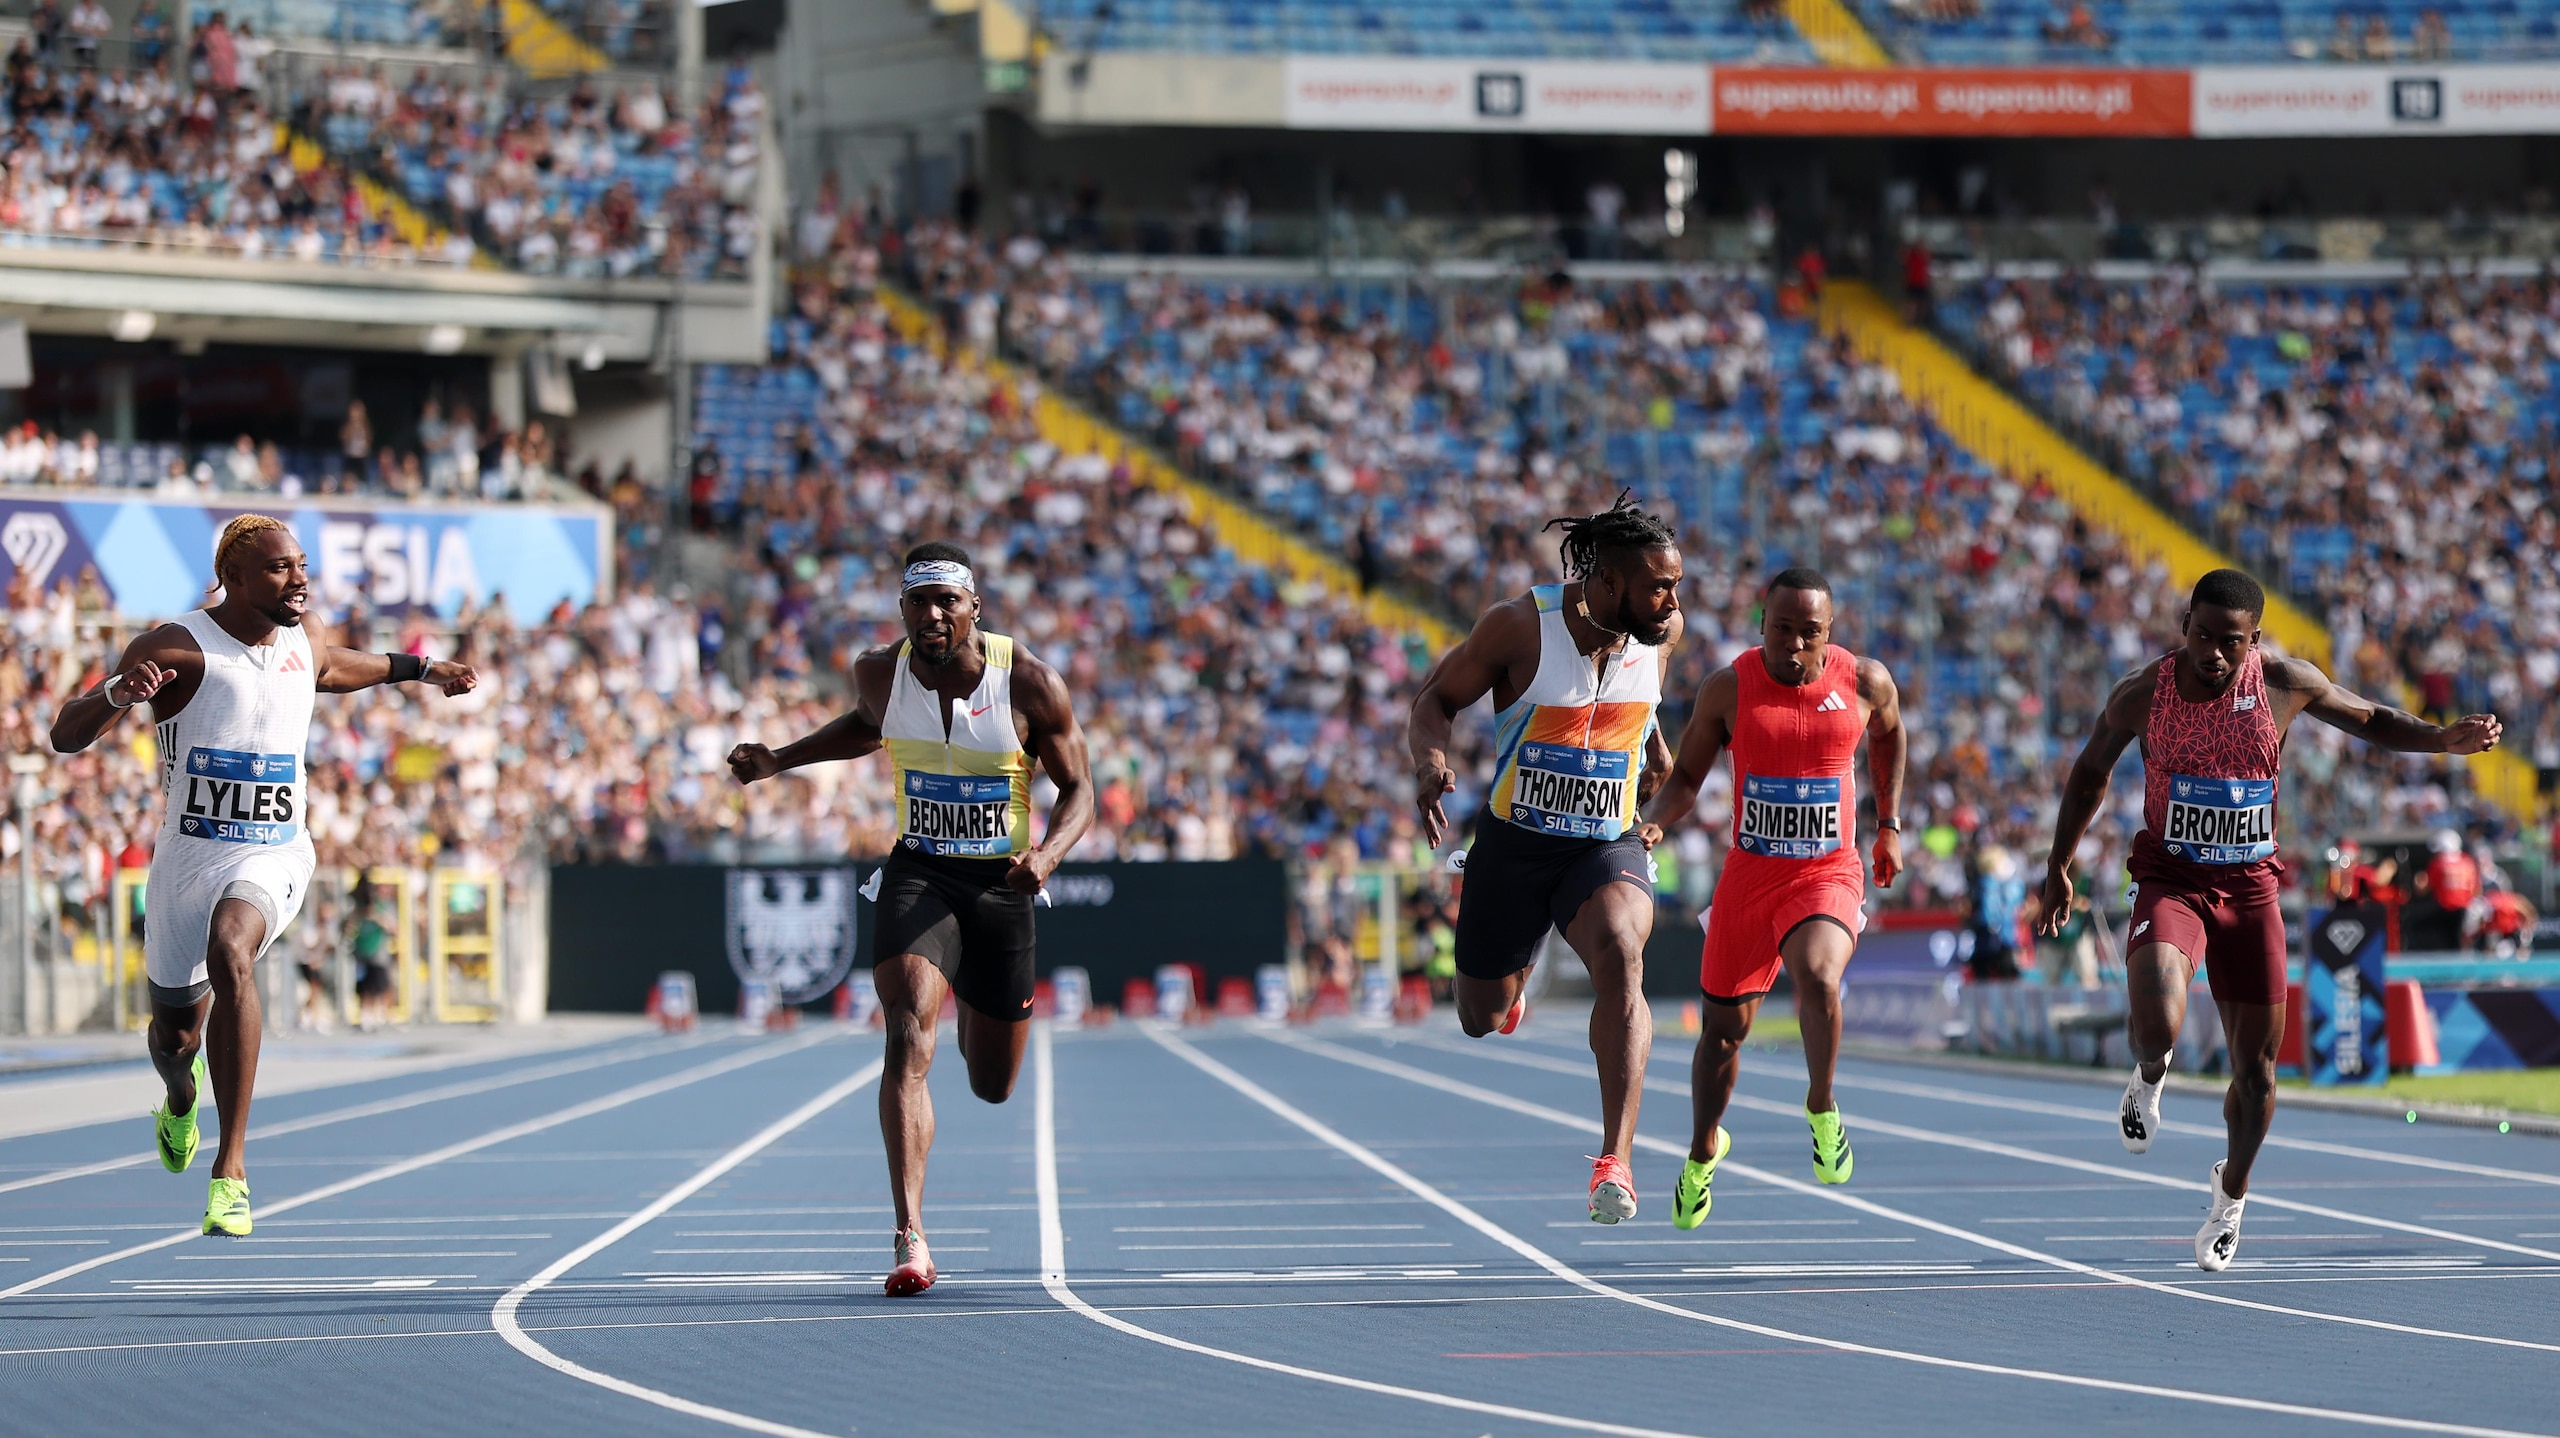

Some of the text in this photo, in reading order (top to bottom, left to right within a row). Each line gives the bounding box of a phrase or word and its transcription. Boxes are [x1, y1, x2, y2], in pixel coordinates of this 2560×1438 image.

[1721, 78, 2133, 121] superauto.pl superauto.pl
[186, 777, 292, 822] LYLES
[1520, 768, 1622, 818] THOMPSON
[218, 824, 281, 841] SILESIA
[909, 798, 1007, 838] BEDNAREK
[1545, 815, 1607, 836] SILESIA
[1744, 800, 1837, 838] SIMBINE
[2170, 803, 2269, 845] BROMELL
[936, 843, 996, 855] SILESIA
[1770, 842, 1827, 856] SILESIA
[2200, 847, 2258, 861] SILESIA
[2334, 963, 2362, 1077] SILESIA
